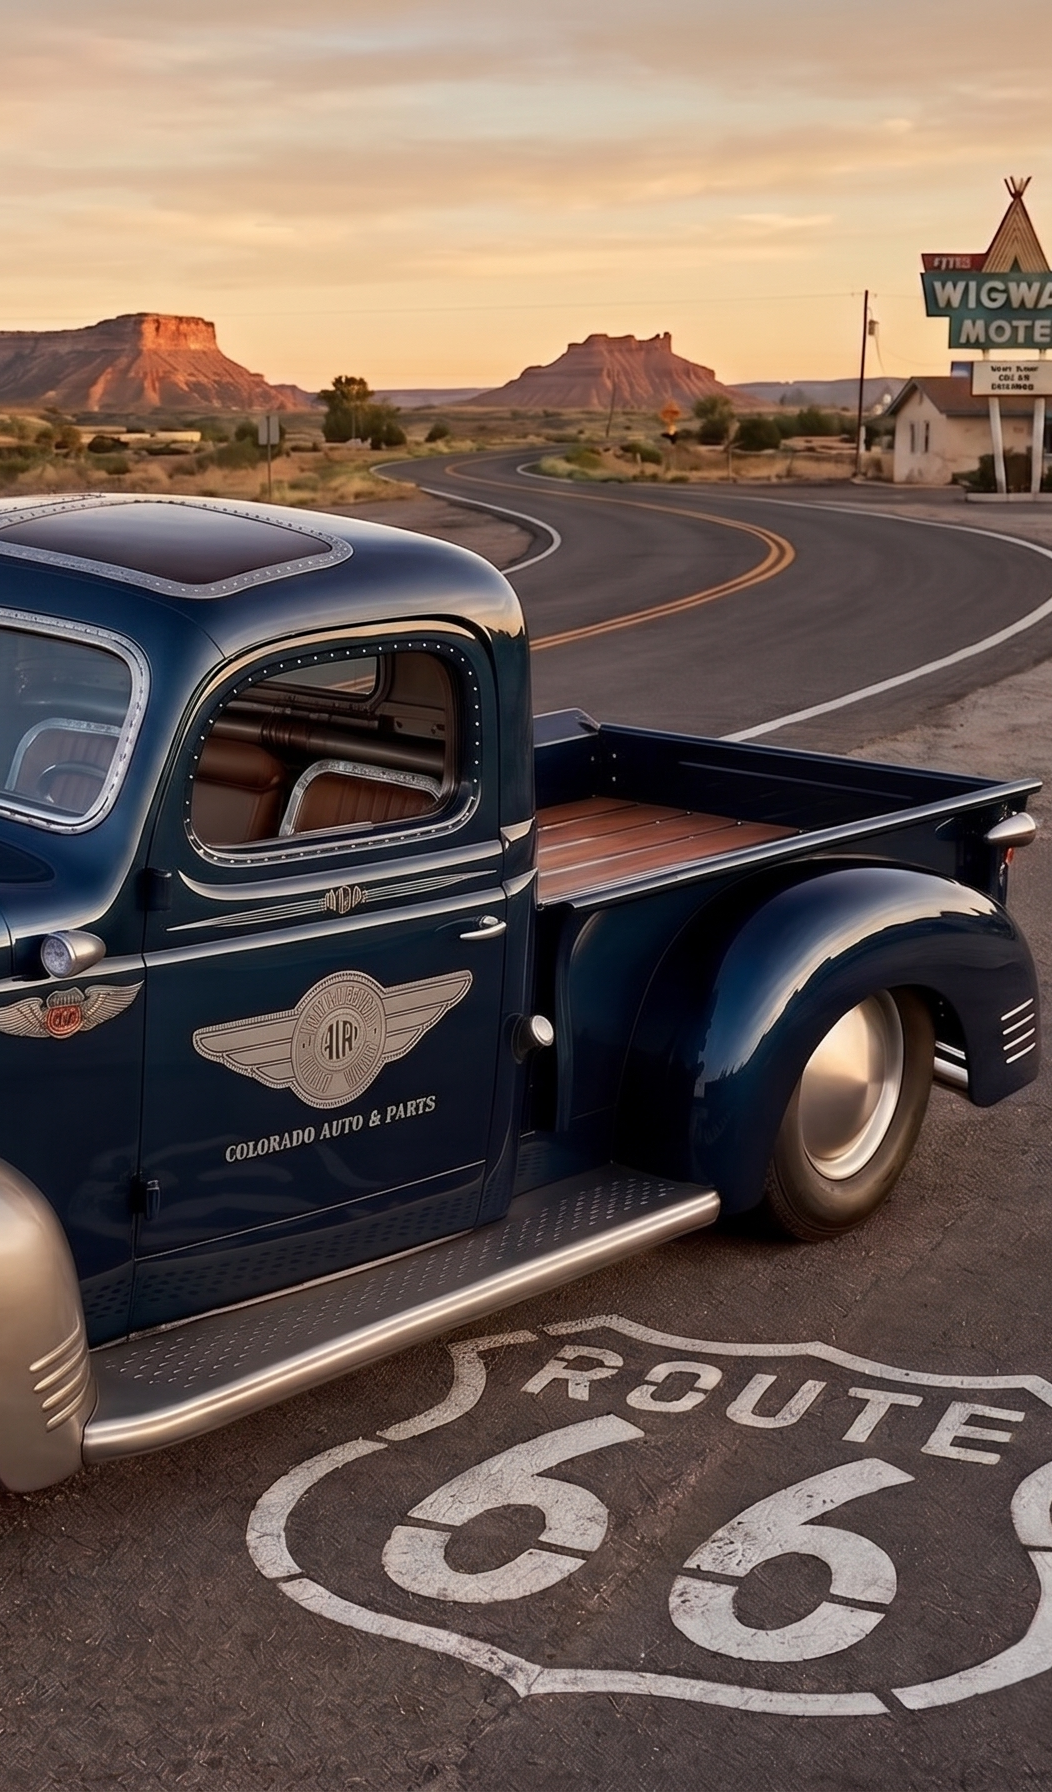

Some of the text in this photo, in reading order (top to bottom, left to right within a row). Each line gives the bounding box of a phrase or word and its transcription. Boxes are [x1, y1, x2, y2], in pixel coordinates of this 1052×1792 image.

[225, 1095, 437, 1163] COLORADO AUTO & PARTS
[520, 1344, 1026, 1465] ROUTE
[381, 1413, 916, 1664] 66
